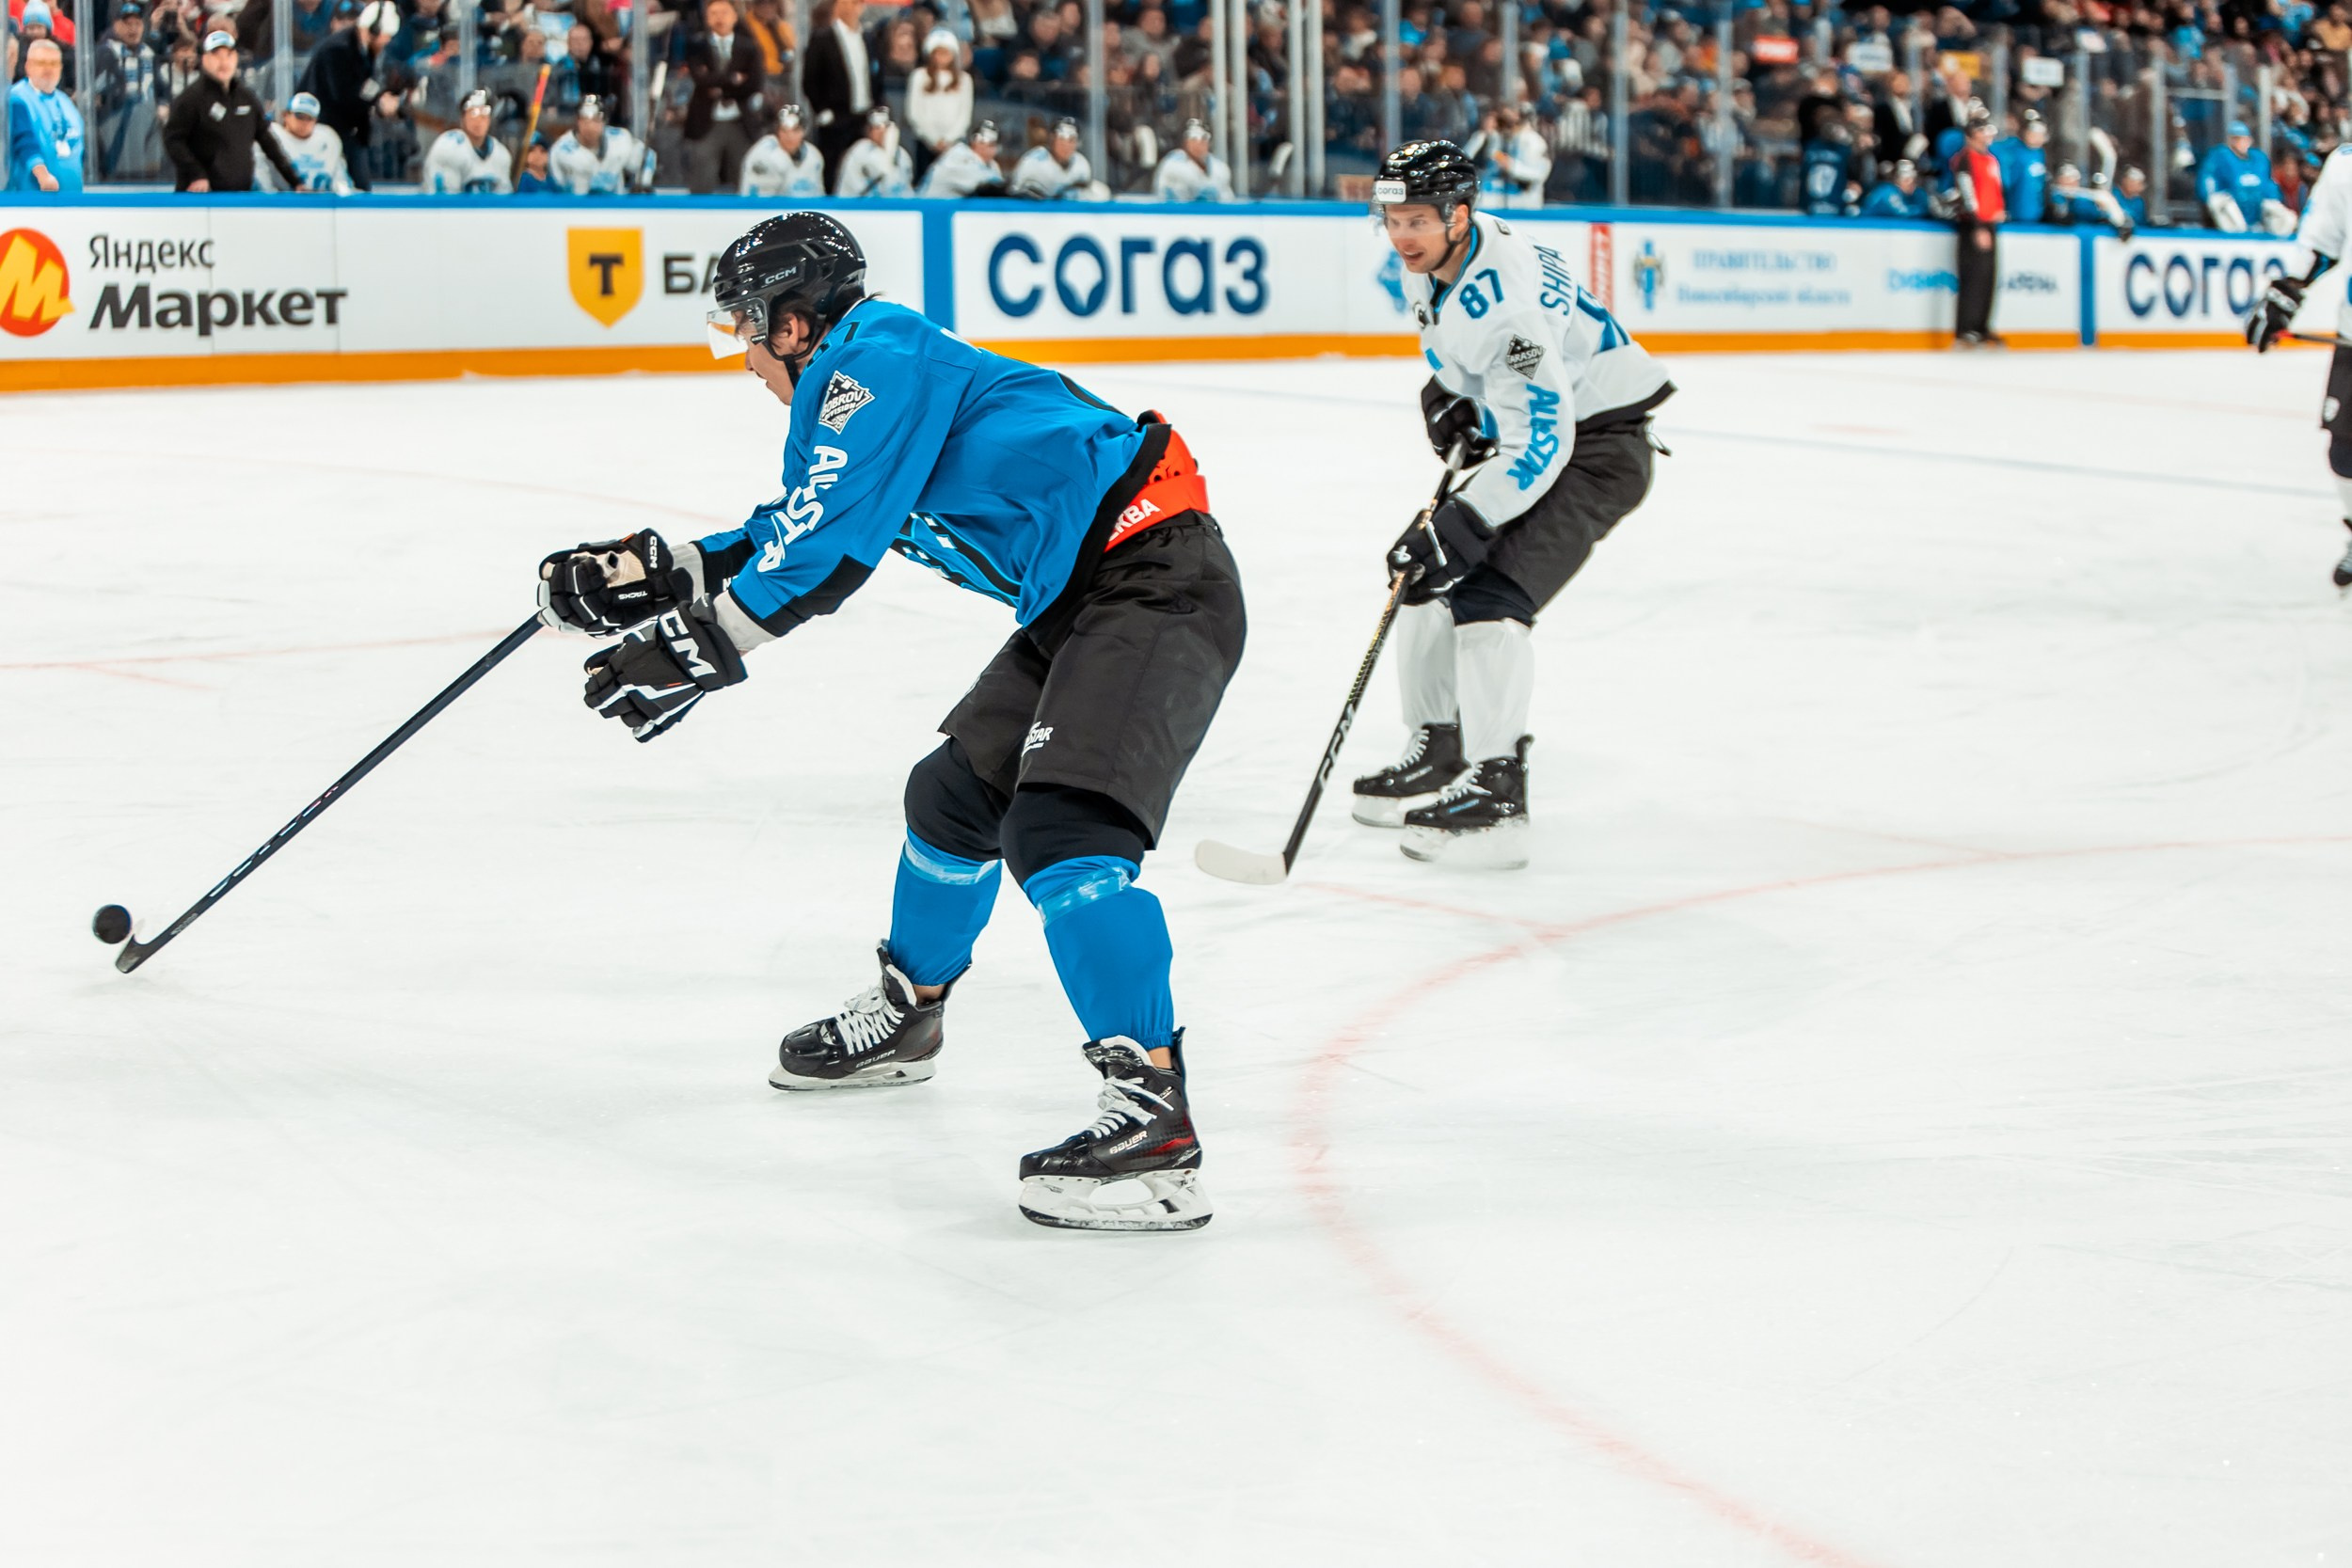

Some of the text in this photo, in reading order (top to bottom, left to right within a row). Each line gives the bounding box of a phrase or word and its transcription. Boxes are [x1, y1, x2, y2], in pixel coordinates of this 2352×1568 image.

[88, 233, 215, 274] Яндекс
[765, 265, 797, 285] CCM
[1459, 268, 1504, 320] 87
[88, 281, 348, 337] Маркет
[1109, 1130, 1148, 1155] BAUER
